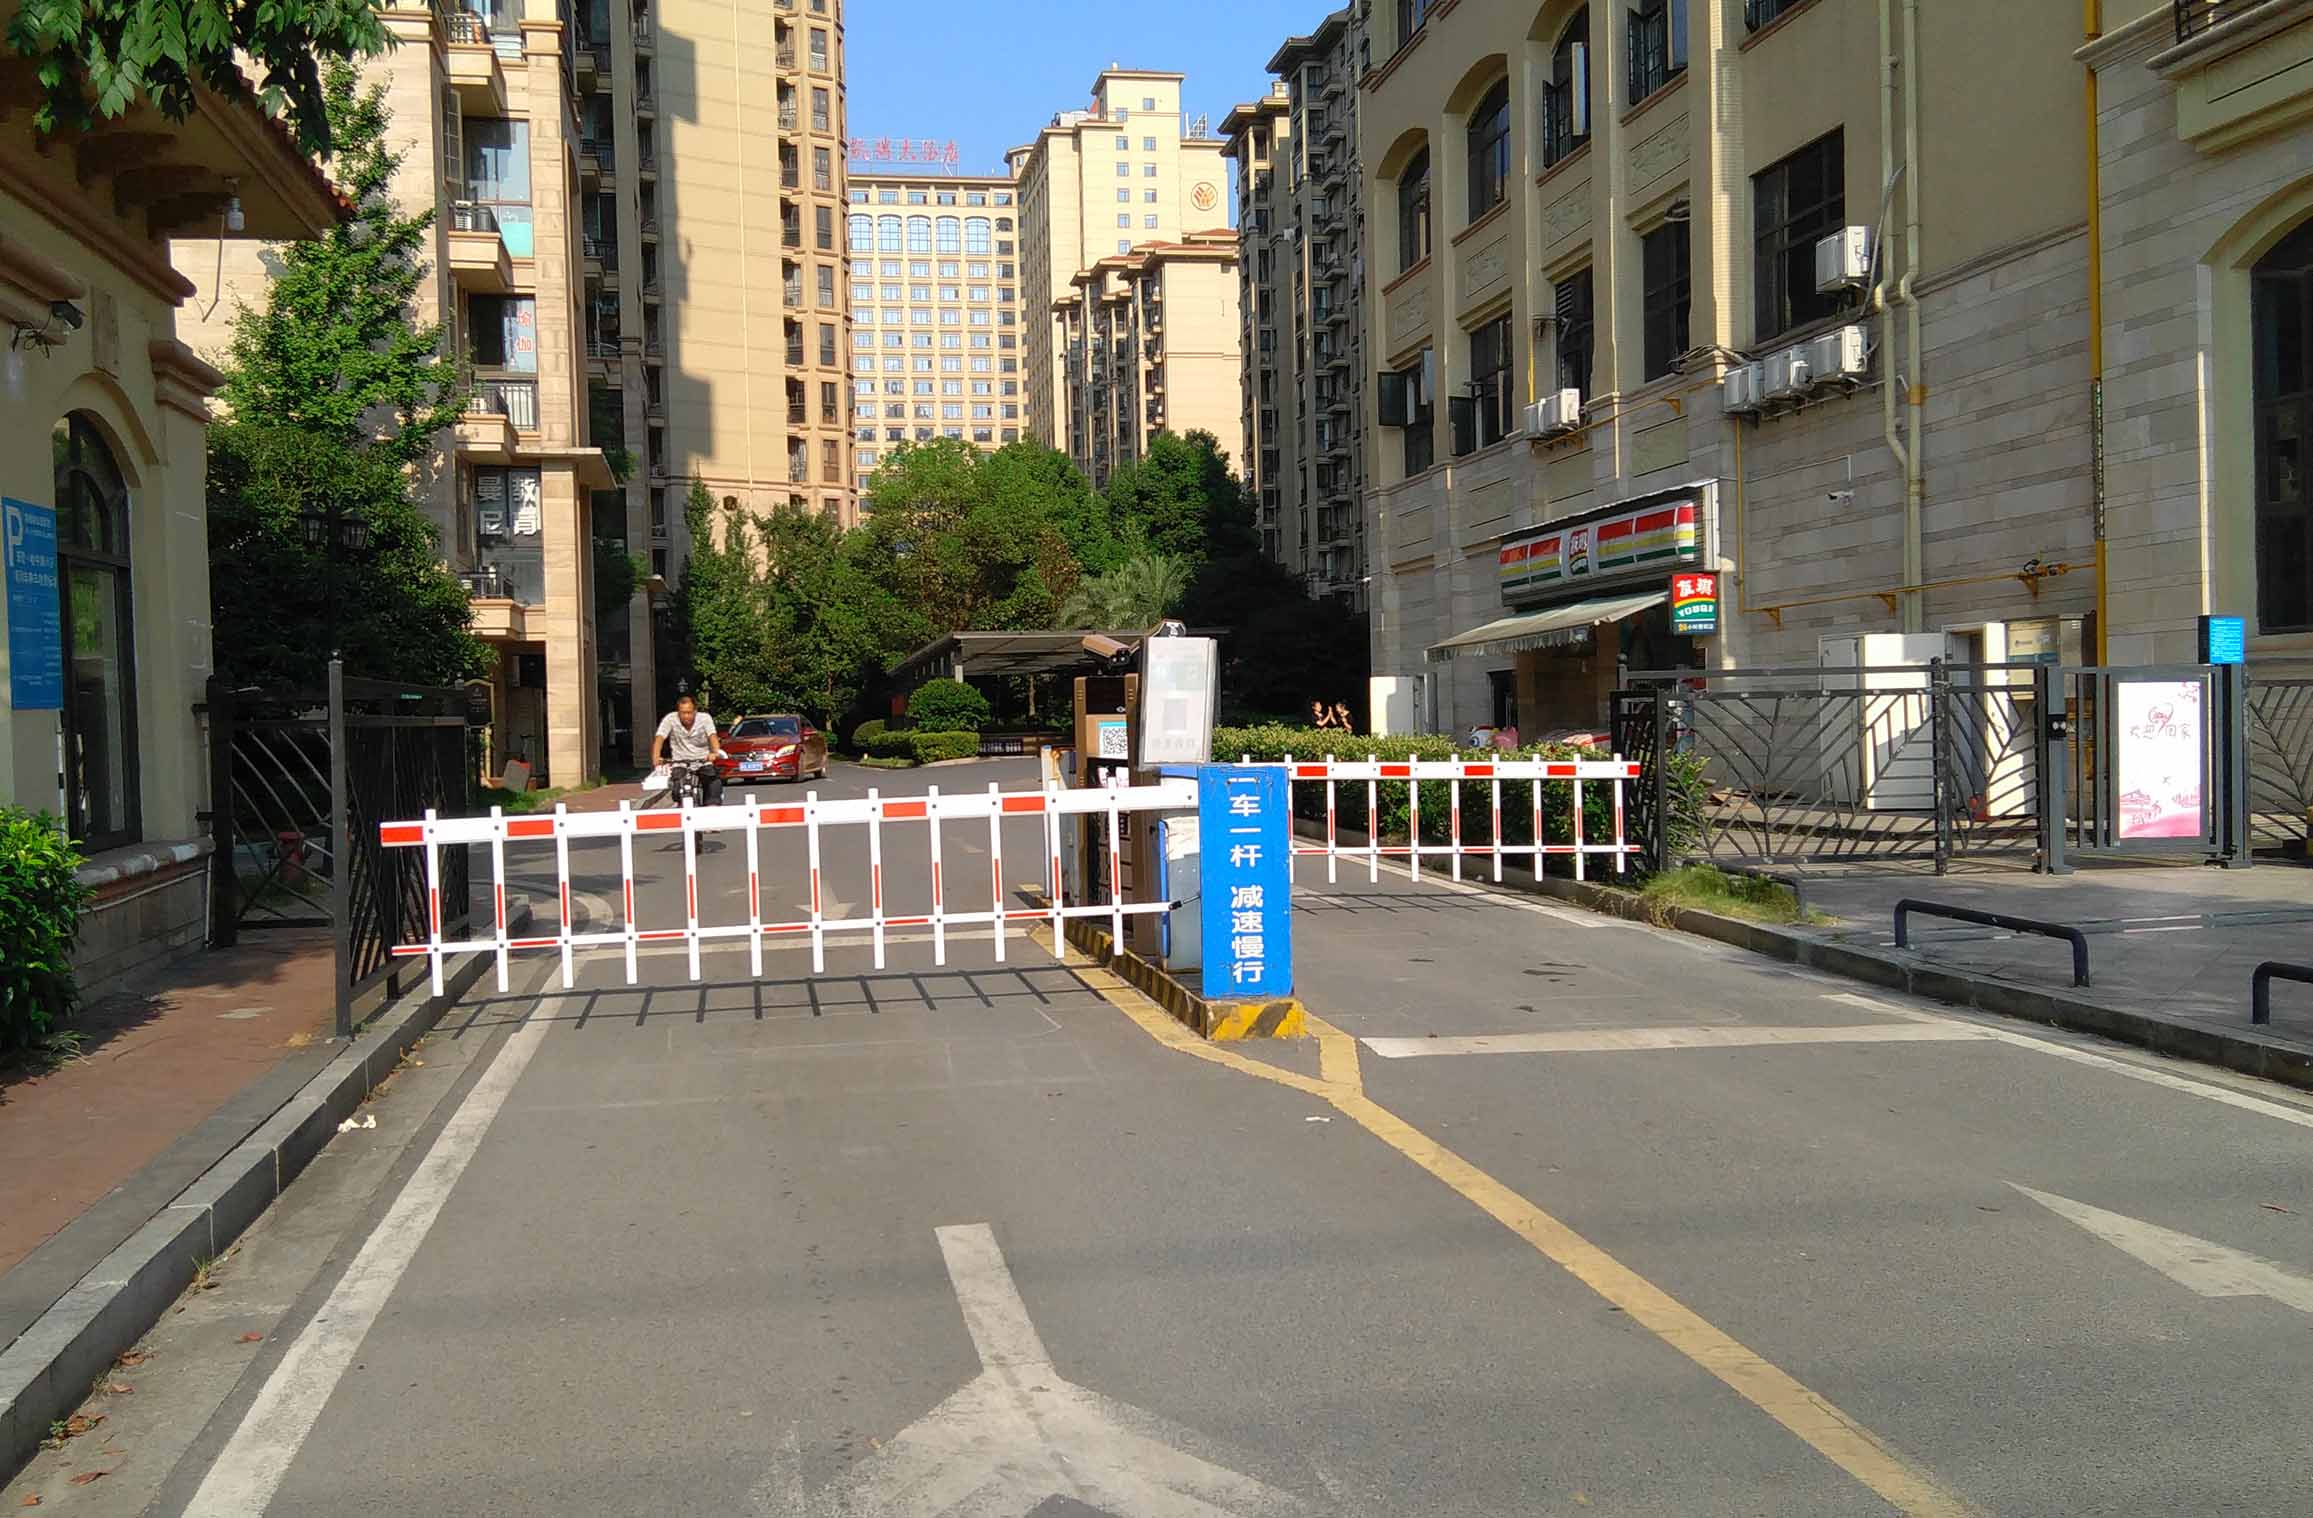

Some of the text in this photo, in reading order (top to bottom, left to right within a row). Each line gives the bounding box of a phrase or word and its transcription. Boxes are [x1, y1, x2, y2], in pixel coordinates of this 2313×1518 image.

[6, 505, 24, 567] P
[511, 475, 538, 536] 教育
[1227, 776, 1263, 868] 一车一杆
[1230, 884, 1264, 984] 减速慢行
